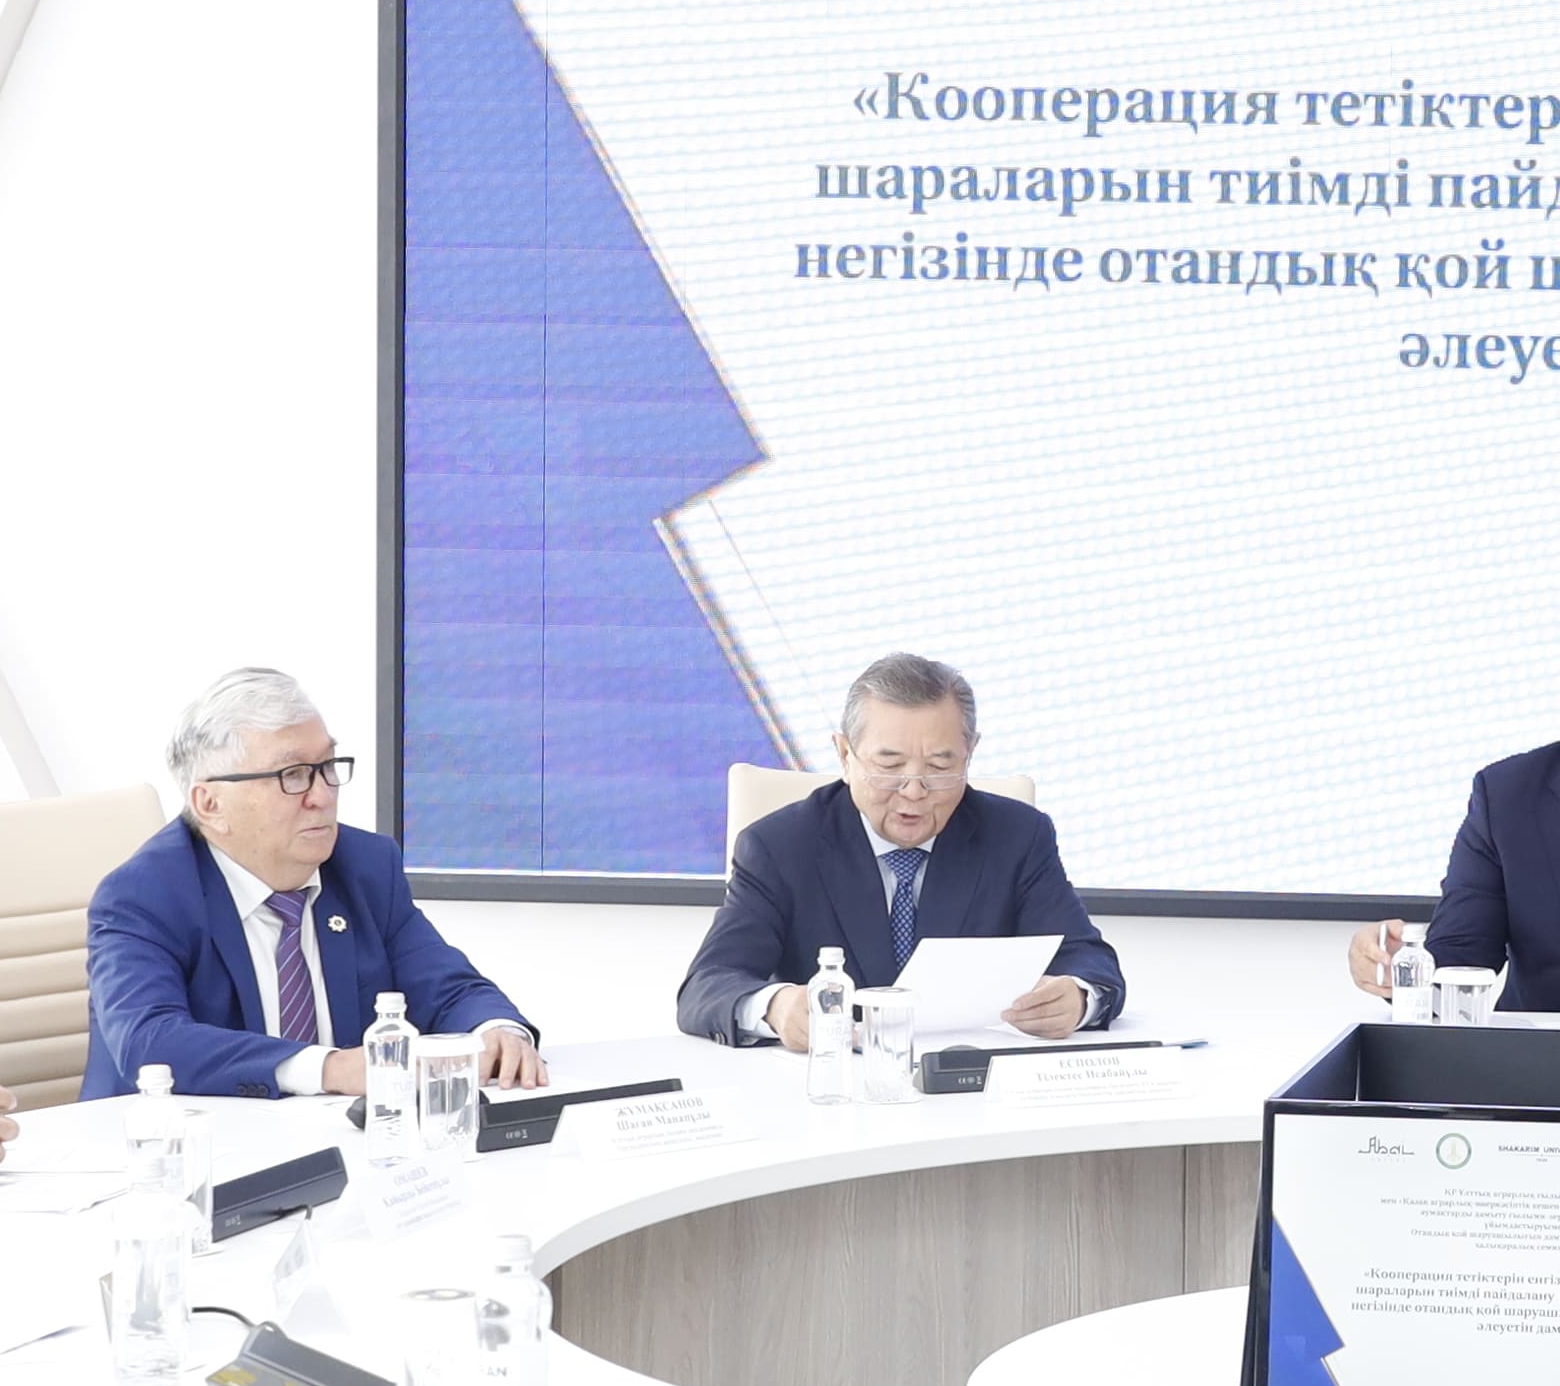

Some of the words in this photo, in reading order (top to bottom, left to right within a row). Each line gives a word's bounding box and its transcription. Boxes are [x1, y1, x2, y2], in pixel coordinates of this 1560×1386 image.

[853, 72, 1279, 138] «Кооперация
[816, 165, 1193, 217] шараларын
[1209, 157, 1411, 215] тиімді
[794, 232, 1085, 288] негізінде
[1099, 249, 1382, 295] отандық
[1395, 238, 1512, 295] қой
[1498, 1145, 1540, 1153] SHAKARIM
